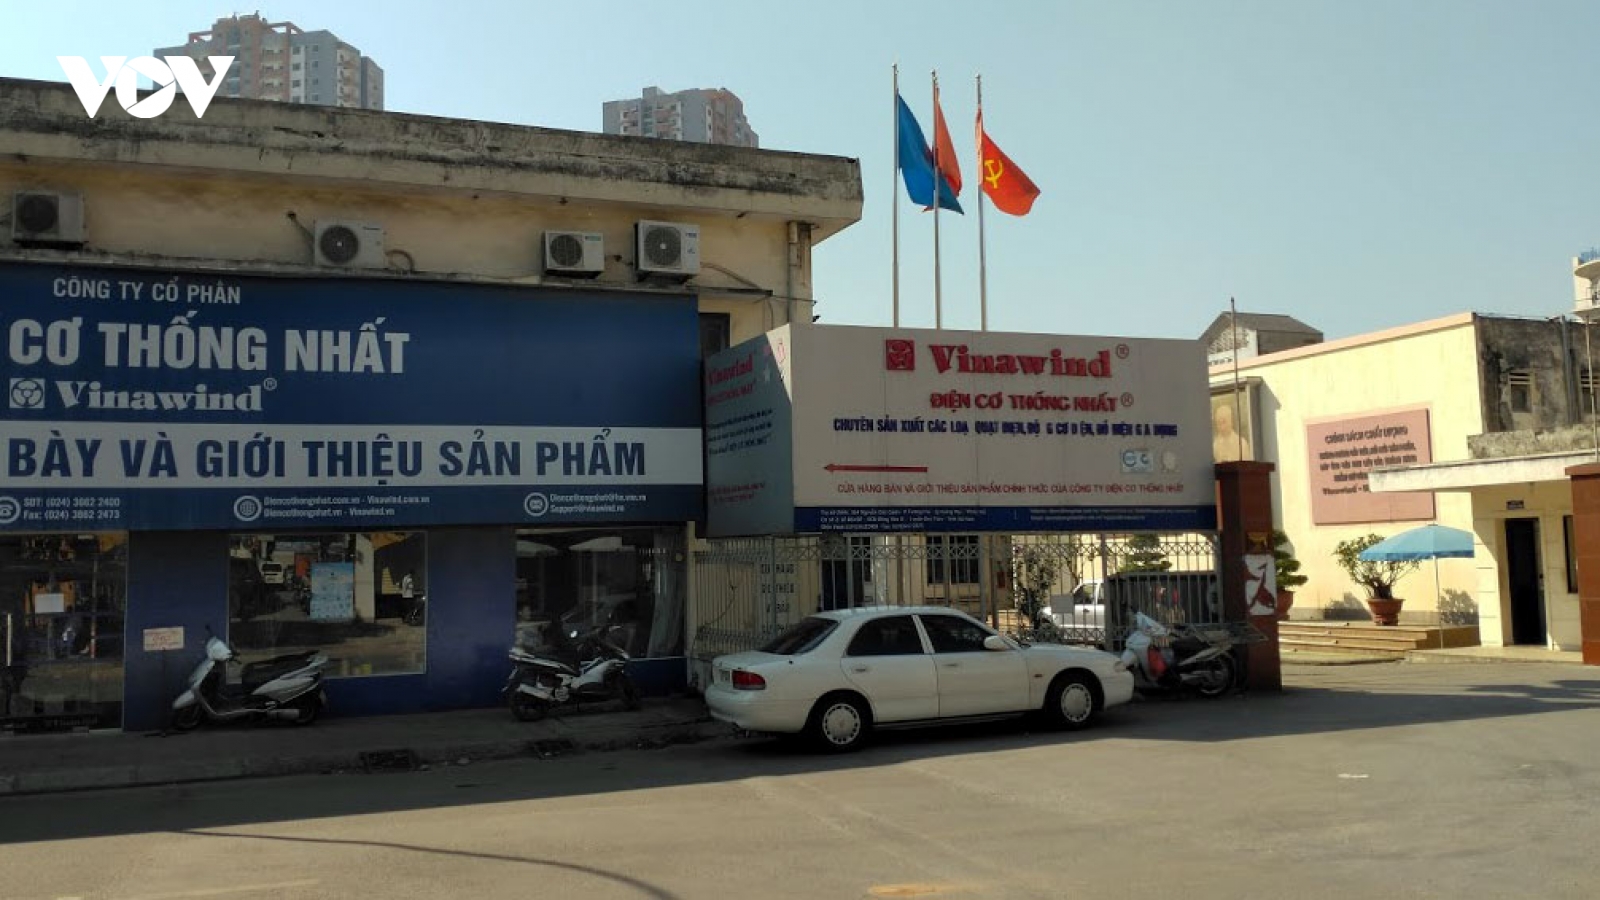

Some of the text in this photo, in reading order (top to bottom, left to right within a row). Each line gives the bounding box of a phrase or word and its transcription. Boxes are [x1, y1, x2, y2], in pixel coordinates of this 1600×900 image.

[53, 276, 110, 299] CÔNG
[118, 281, 143, 300] TY
[152, 276, 179, 302] CỔ
[9, 311, 410, 373] CƠ THỐNG NHẤT
[928, 345, 1112, 378] Vinawind
[55, 380, 263, 412] Vinawind
[930, 389, 971, 412] ĐIỆN
[975, 392, 1003, 409] CƠ
[1008, 391, 1069, 410] THỐNG
[1074, 393, 1119, 412] NHẤT
[833, 416, 874, 432] CHUYÊN
[877, 414, 897, 432] SẢN
[901, 416, 925, 432] XUẤT
[928, 418, 946, 432] CÁC
[8, 428, 646, 485] BÀY VÀ GIỚI THIỆU SẢN PHẨM
[44, 510, 69, 520] (024)
[46, 497, 70, 507] (024)
